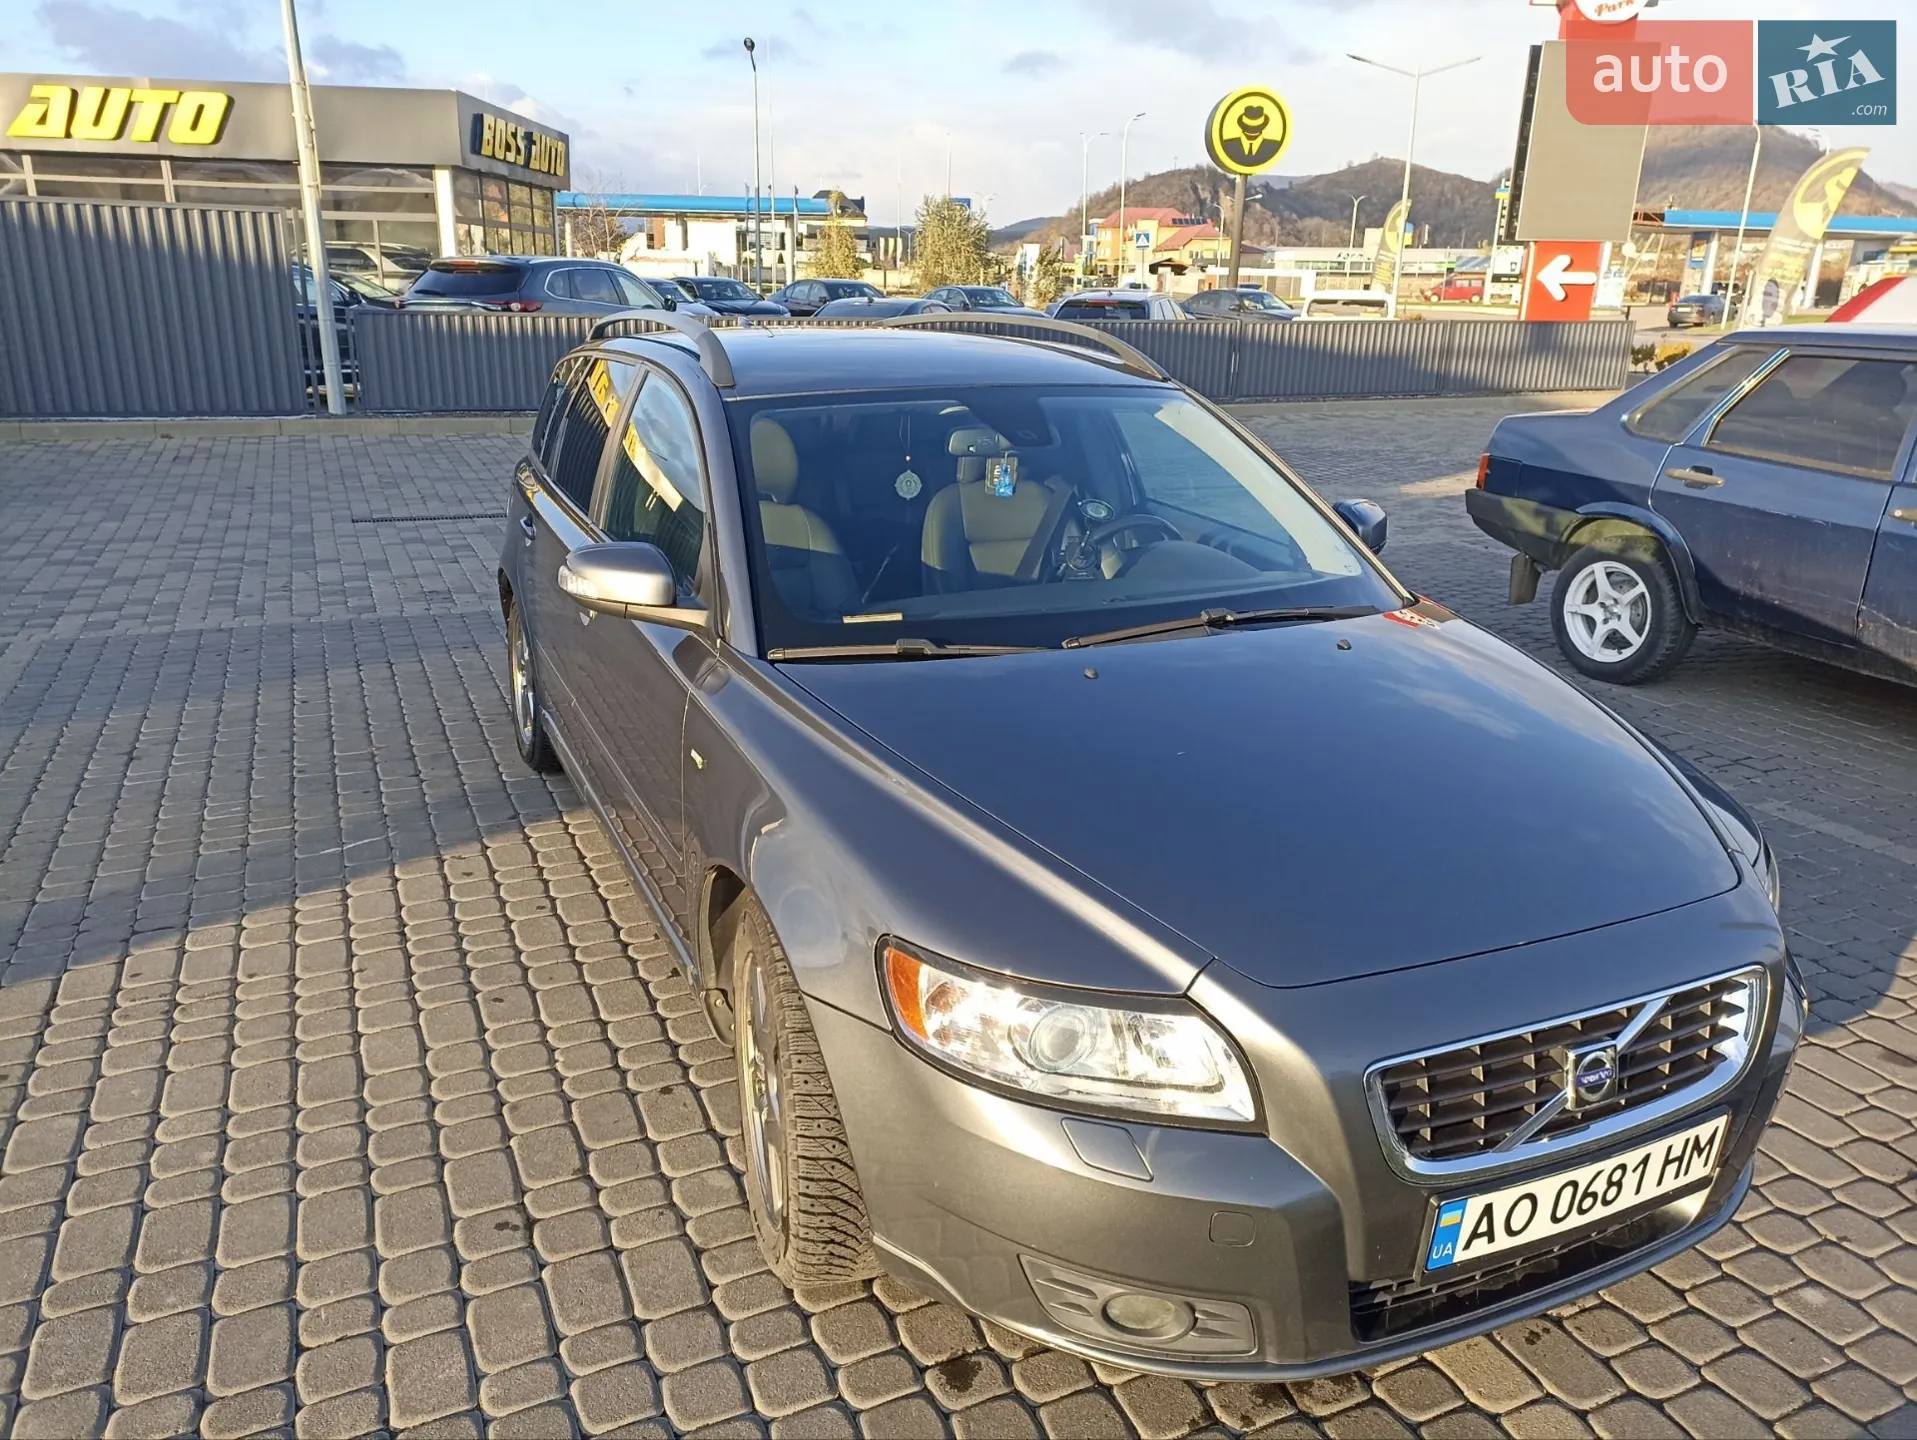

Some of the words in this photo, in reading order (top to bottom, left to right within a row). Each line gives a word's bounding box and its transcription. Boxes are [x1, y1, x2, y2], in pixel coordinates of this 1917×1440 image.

[6, 84, 229, 144] AUTO
[480, 113, 525, 166] BOSS
[529, 131, 565, 177] AUTO
[1462, 1192, 1538, 1251] AO
[1550, 1152, 1652, 1225] 0681
[1656, 1125, 1719, 1188] HM
[1432, 1244, 1453, 1259] UA
